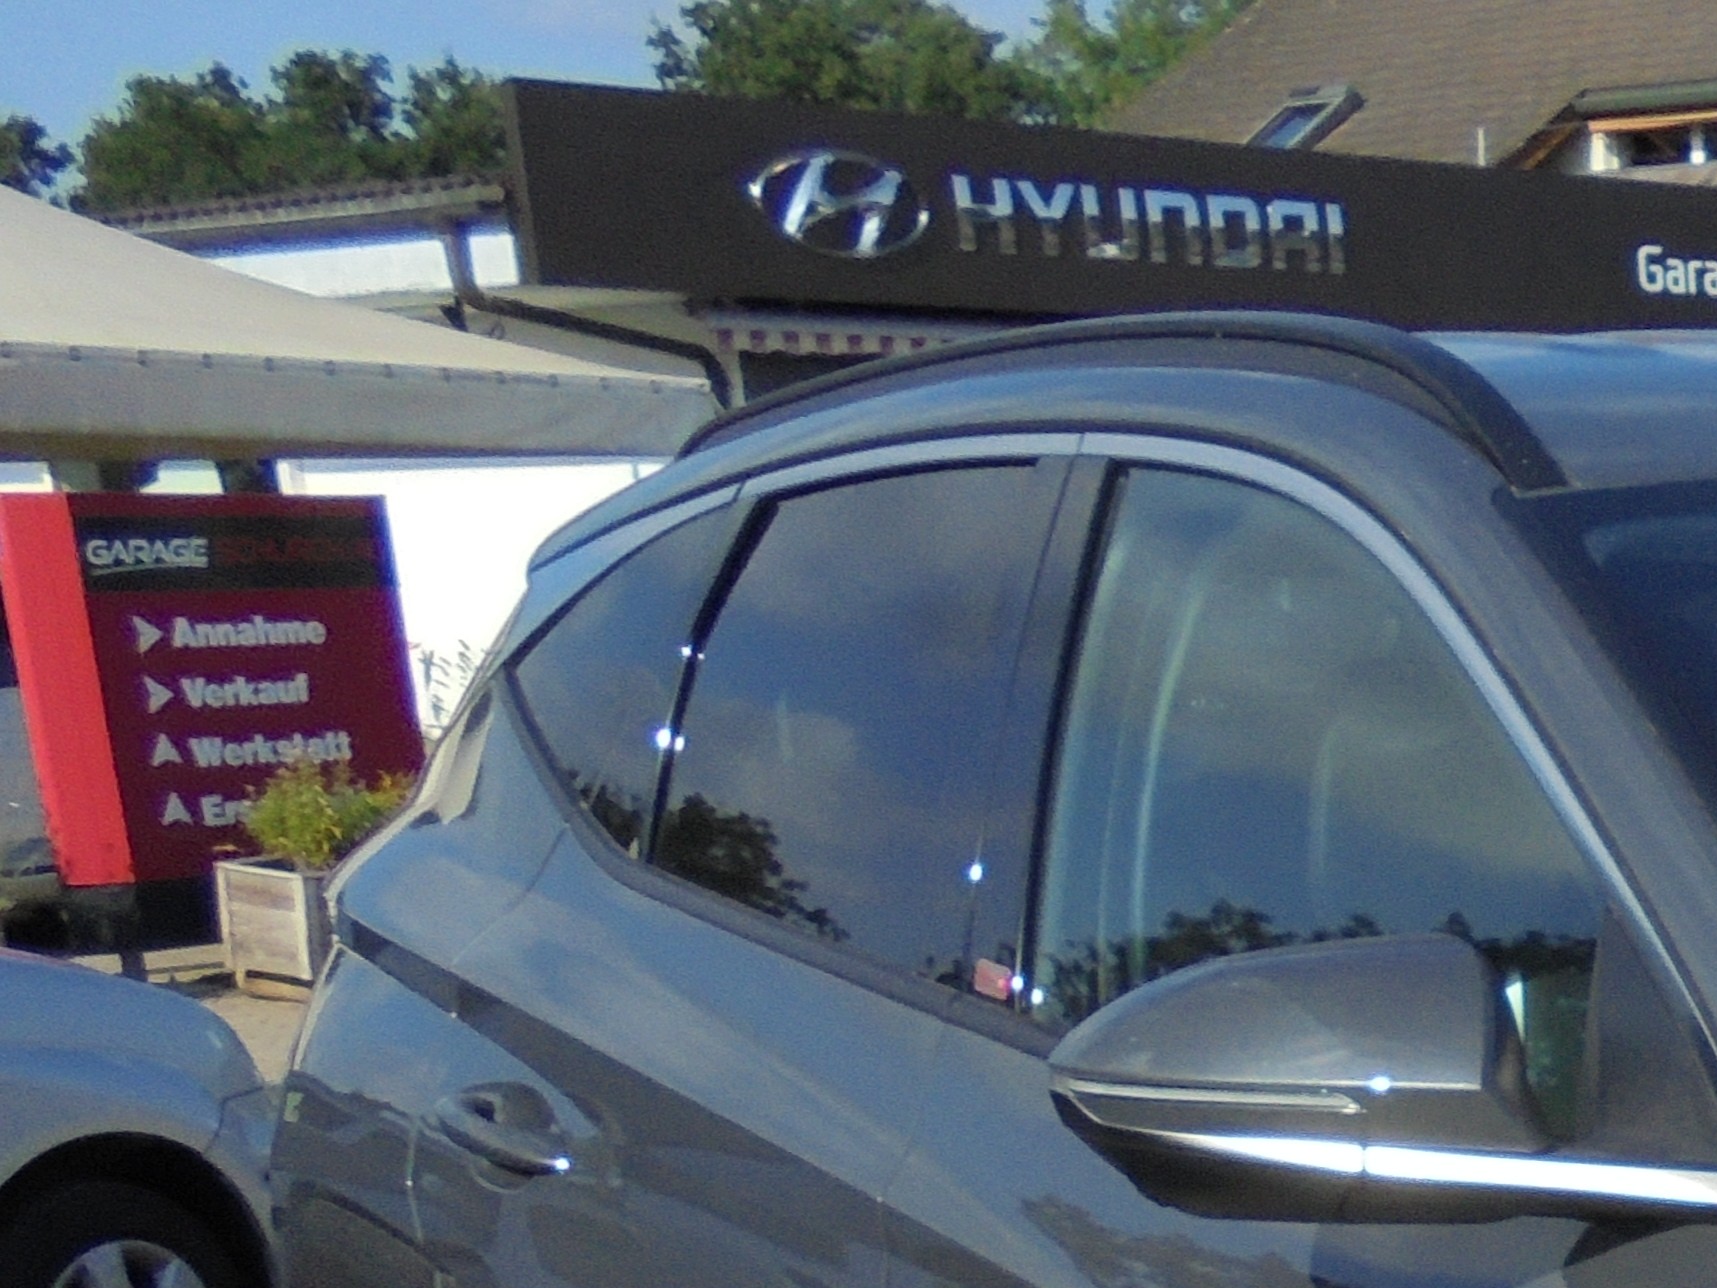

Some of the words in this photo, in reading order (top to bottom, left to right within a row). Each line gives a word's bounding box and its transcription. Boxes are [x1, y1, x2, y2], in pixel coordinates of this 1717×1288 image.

[949, 172, 1347, 275] HYUNDAI
[86, 536, 209, 569] GARAGE
[172, 614, 327, 649] Annahme
[180, 672, 310, 709] Verkauf
[187, 730, 353, 768] Werkstatt
